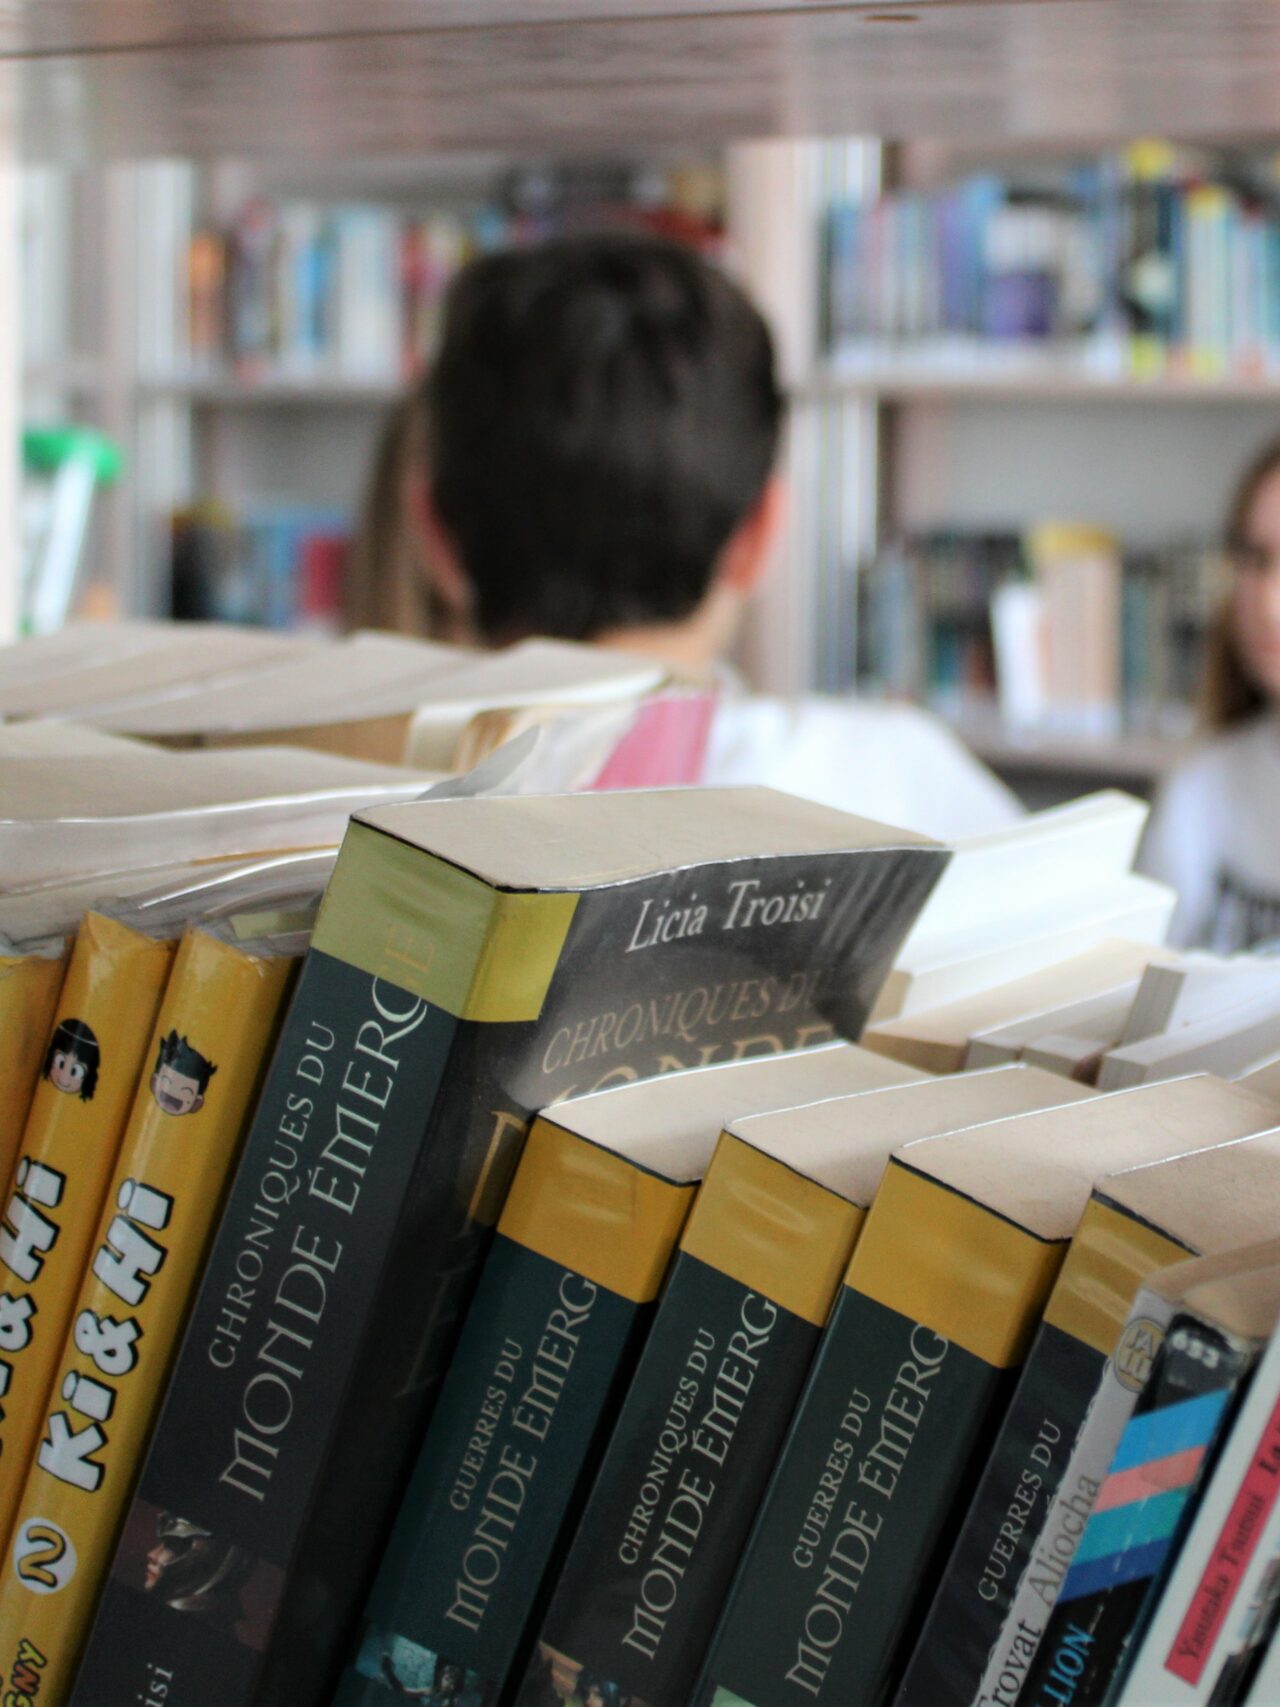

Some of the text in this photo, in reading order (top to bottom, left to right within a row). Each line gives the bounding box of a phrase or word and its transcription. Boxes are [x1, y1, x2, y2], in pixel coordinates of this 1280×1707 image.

[625, 879, 832, 953] Licia Troisi
[541, 974, 778, 1074] CHRONIQUES
[208, 1021, 336, 1368] CHRONIQUES DU
[36, 1177, 175, 1493] Ki & Hi
[219, 1225, 343, 1501] MONDE
[449, 1337, 525, 1511] GUERRES DU
[444, 1443, 538, 1631] MONDE
[618, 1327, 717, 1566] CHRONIQUES DU
[791, 1388, 873, 1569] GUERRES DU
[977, 1418, 1062, 1601] GUERRES DU
[17, 1524, 67, 1588] 2
[622, 1469, 716, 1660] MONDE
[785, 1501, 883, 1697] MONDE
[1028, 1475, 1101, 1609] Aliocha
[1042, 1623, 1097, 1706] LION
